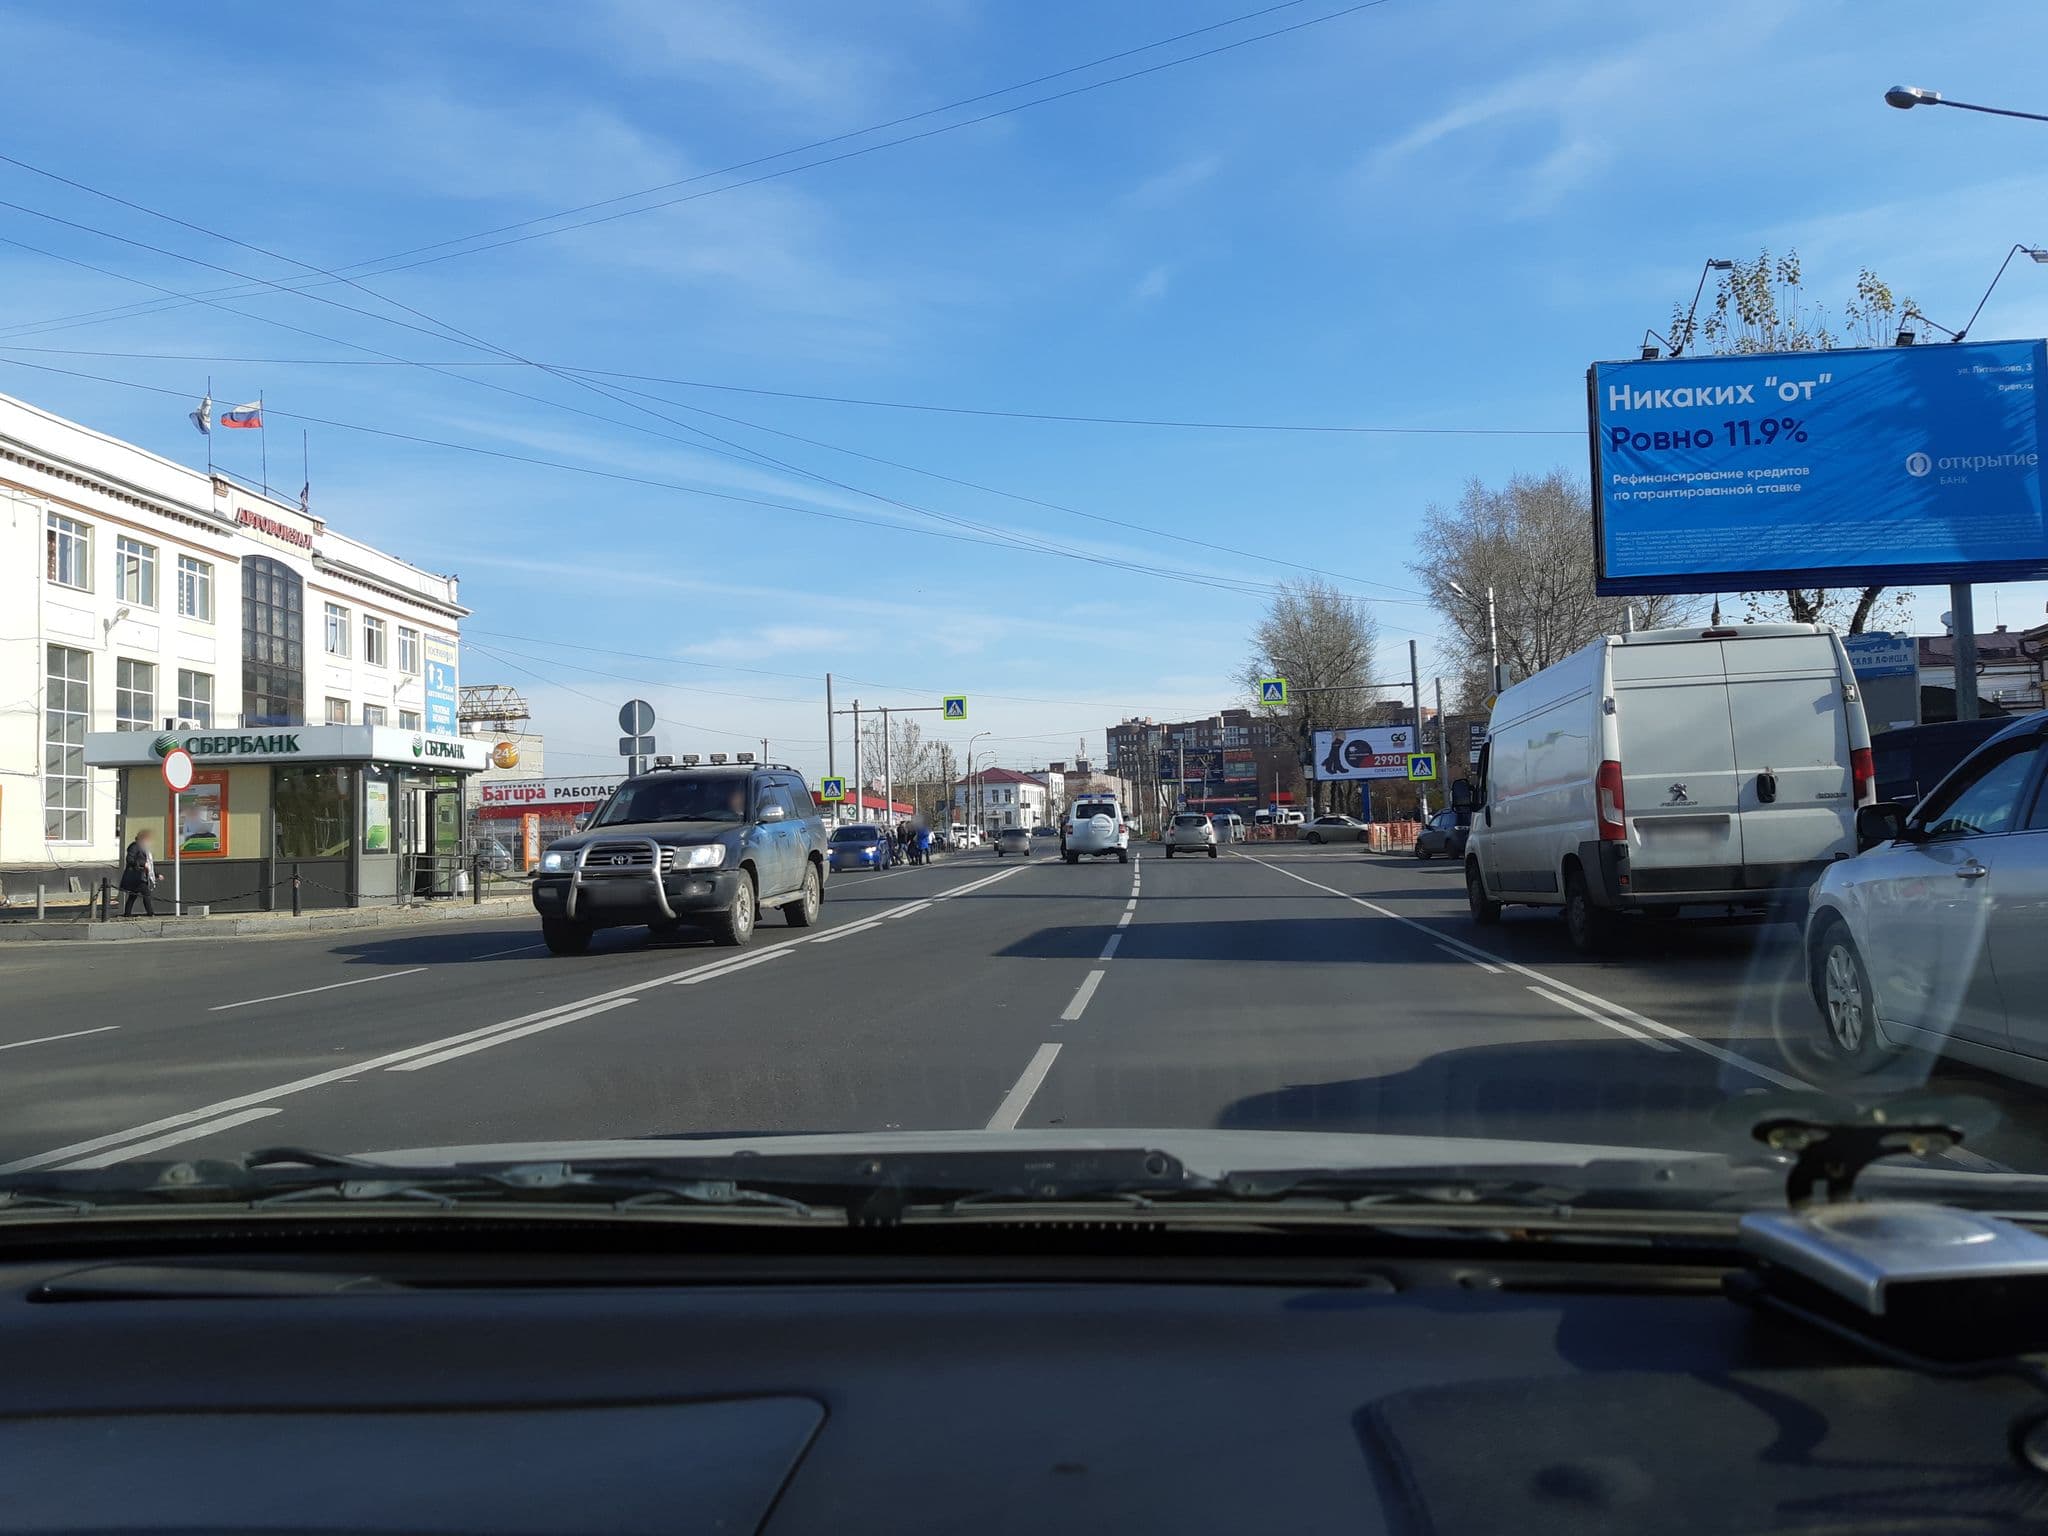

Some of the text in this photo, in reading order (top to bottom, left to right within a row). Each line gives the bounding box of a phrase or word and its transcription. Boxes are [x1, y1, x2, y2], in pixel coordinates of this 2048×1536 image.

[2026, 363, 2033, 371] 3
[1608, 384, 1755, 411] Никаких
[1611, 417, 1809, 453] Ровно 11.9%
[1938, 453, 2039, 472] открытие
[1613, 467, 1810, 487] Рефинансирование кредитов
[1940, 475, 1968, 485] БАНК
[1613, 482, 1801, 501] по гарантированной ставке
[185, 734, 301, 754] СБЕРБАНК
[424, 739, 465, 760] СБЕРБАНК
[1374, 755, 1401, 766] 2990
[482, 785, 621, 803] Багира РАБОТАЕ
